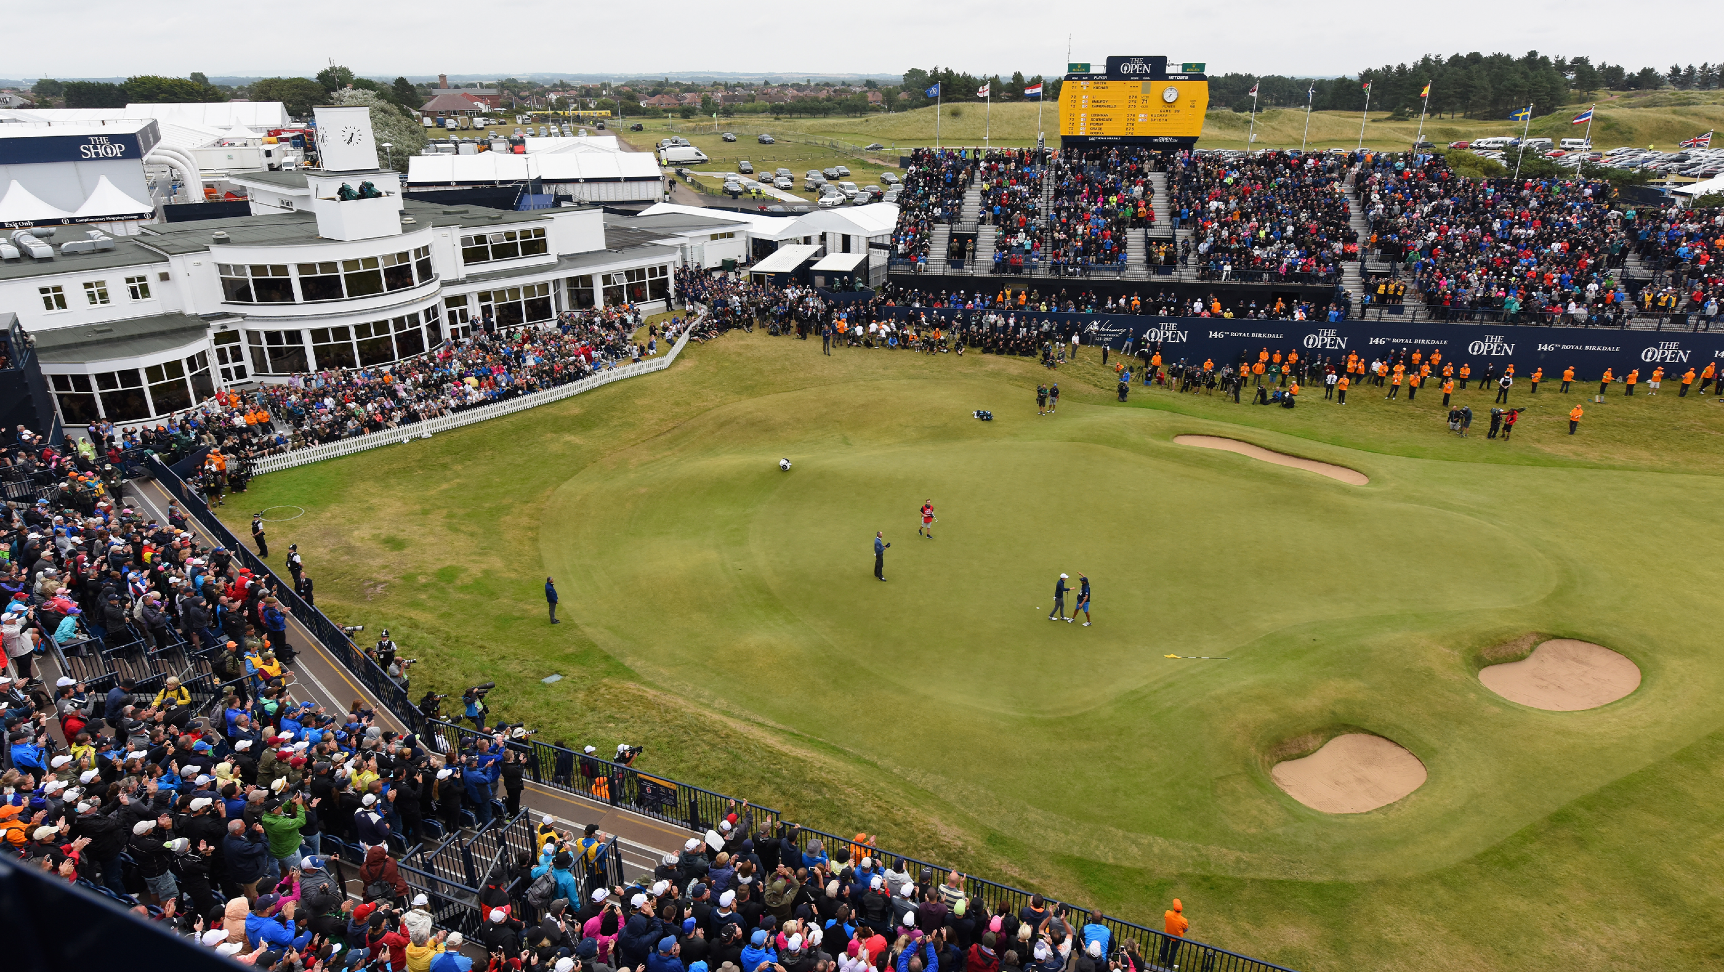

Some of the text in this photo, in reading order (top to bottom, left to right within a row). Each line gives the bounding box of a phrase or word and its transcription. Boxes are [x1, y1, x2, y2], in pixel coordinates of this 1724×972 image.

[1120, 63, 1152, 74] OPEN
[80, 144, 125, 158] SHOP
[1146, 328, 1188, 342] OPEN
[1303, 334, 1348, 349] OPEN
[1468, 340, 1515, 356] OPEN
[1641, 347, 1691, 362] OPEN
